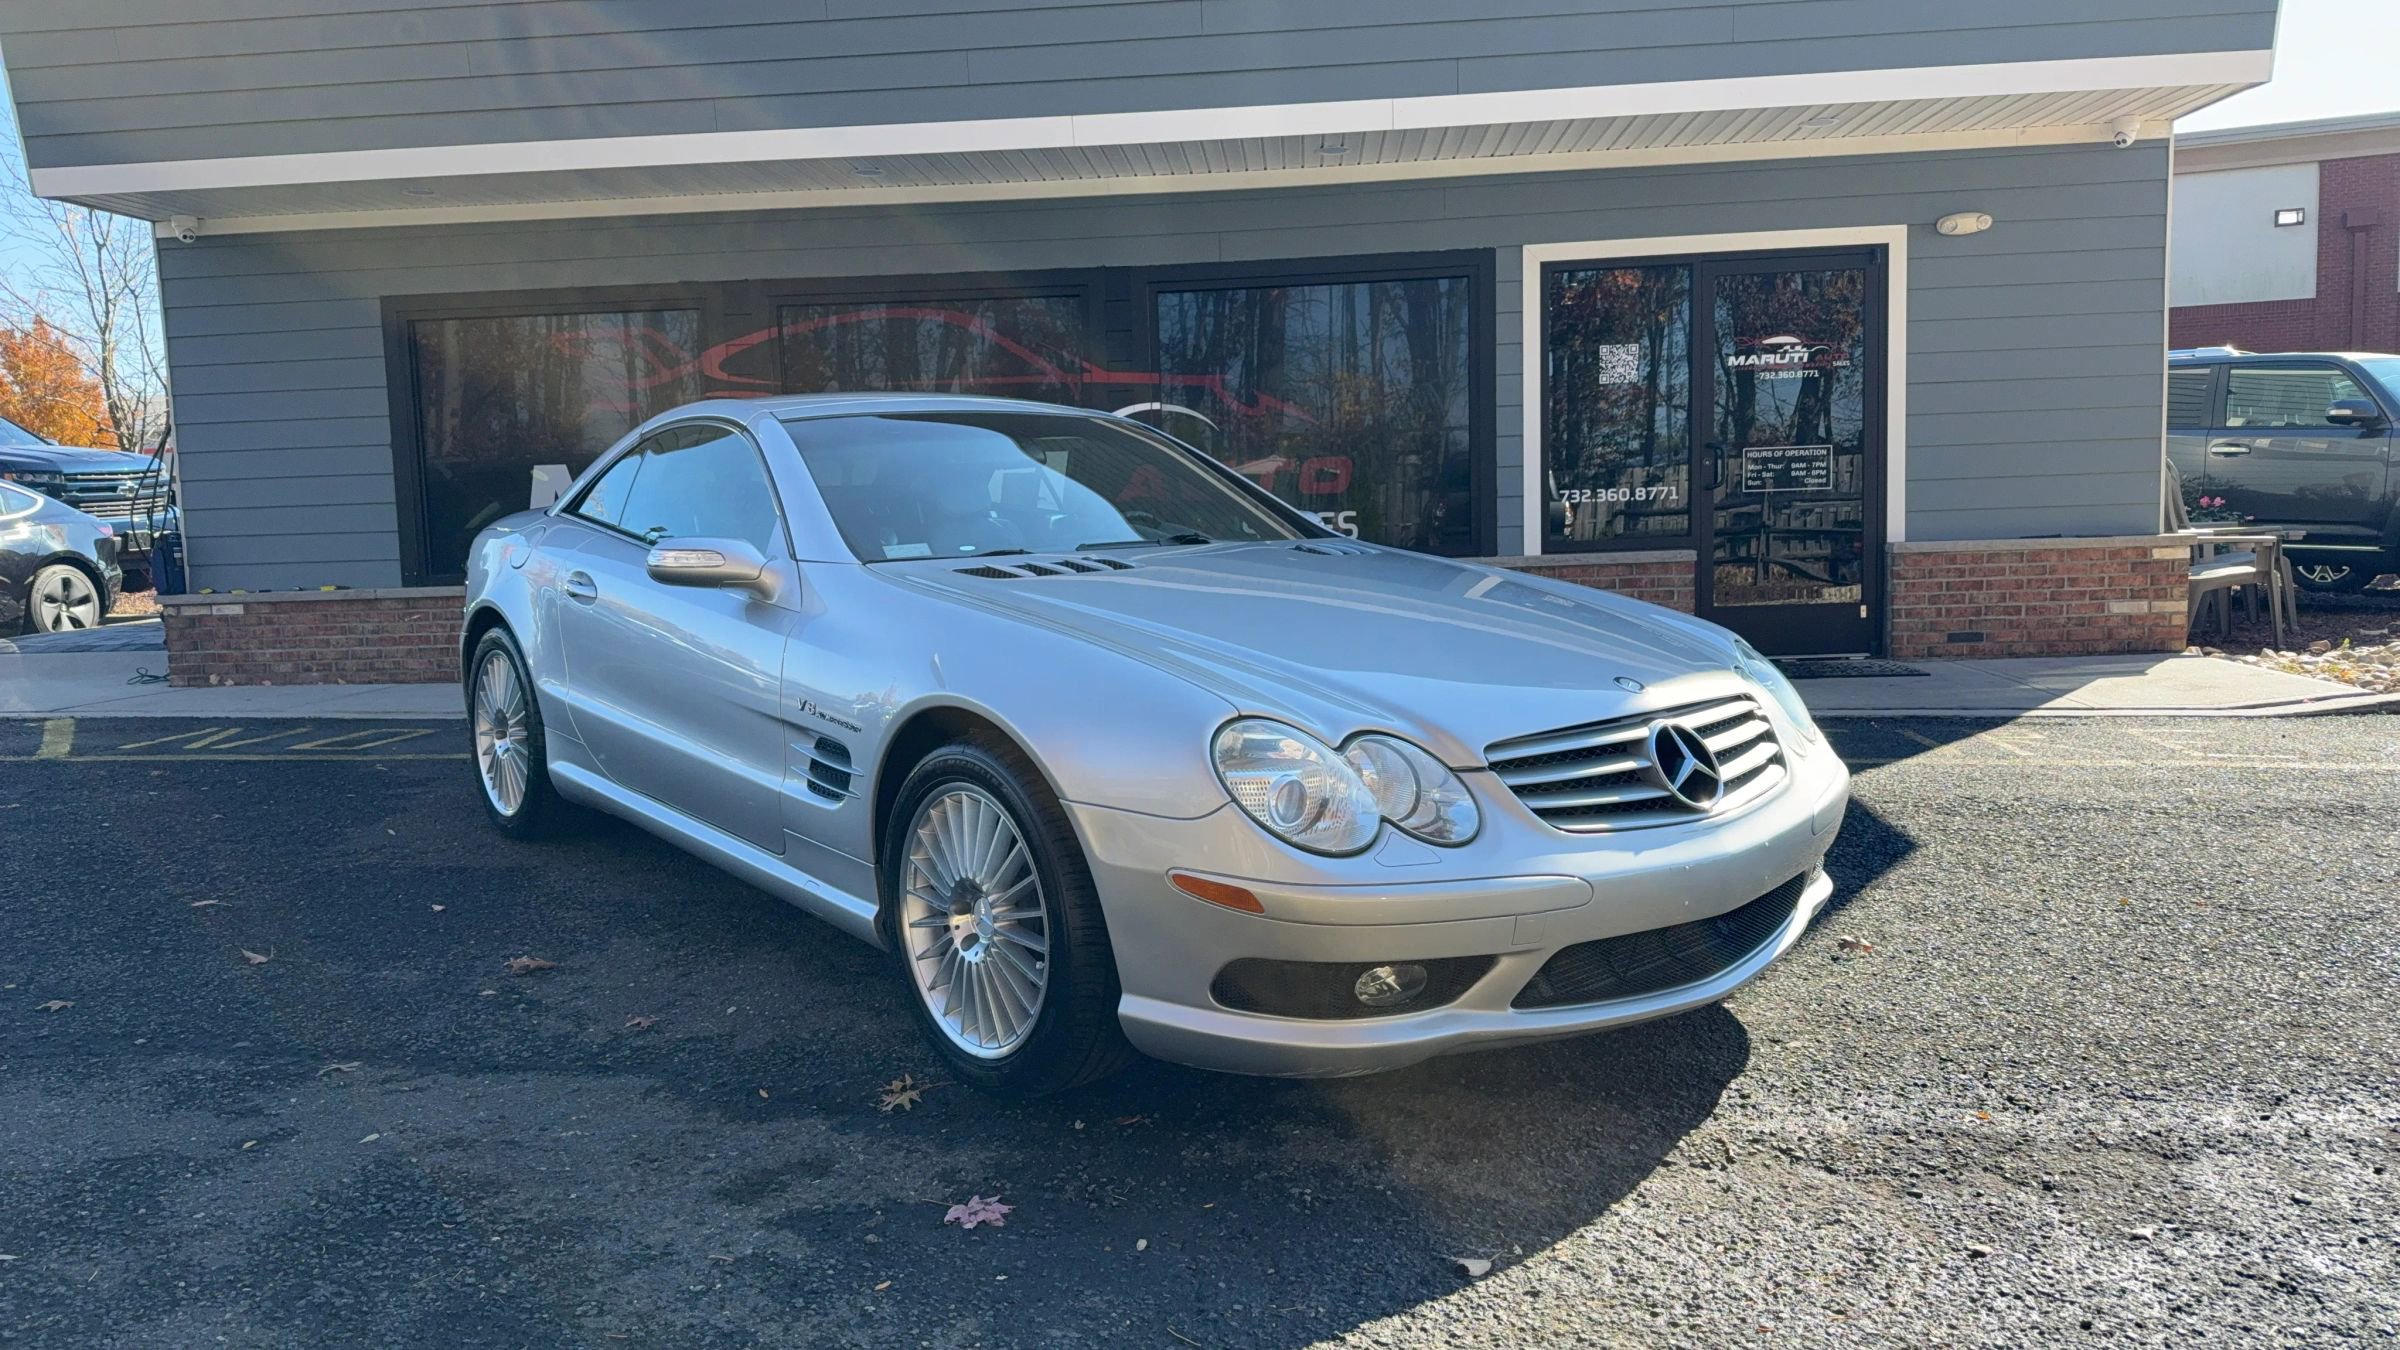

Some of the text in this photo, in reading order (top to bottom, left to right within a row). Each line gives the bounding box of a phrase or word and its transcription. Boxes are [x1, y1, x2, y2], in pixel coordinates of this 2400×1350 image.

[1728, 352, 1809, 366] MARUTI
[1759, 369, 1820, 380] 732.360.8771
[1746, 450, 1773, 458] HOURS
[1784, 448, 1827, 457] OPERATION
[1791, 469, 1806, 477] 9AM
[1559, 486, 1679, 503] 732.360.8771
[797, 697, 817, 716] V8
